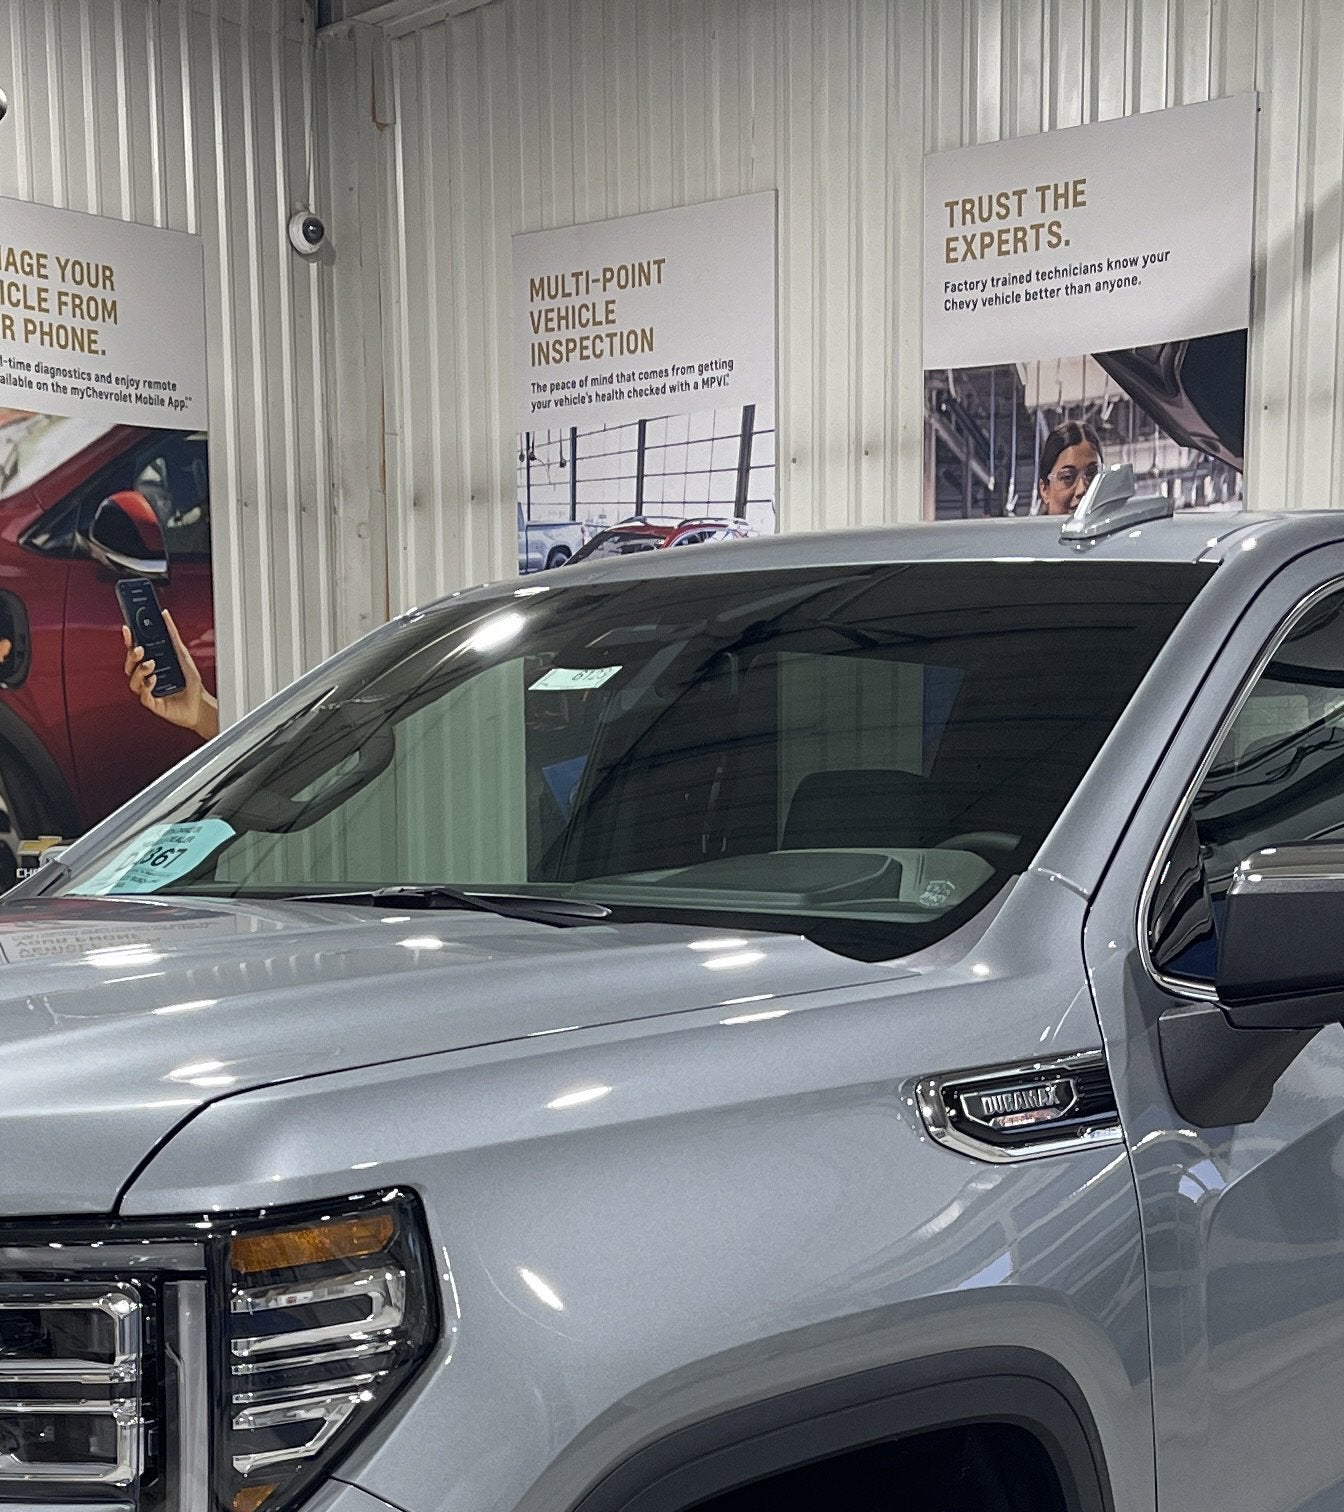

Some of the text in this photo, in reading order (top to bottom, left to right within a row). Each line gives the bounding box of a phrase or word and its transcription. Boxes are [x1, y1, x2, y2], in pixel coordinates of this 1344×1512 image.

[944, 178, 1087, 228] TRUST THE
[945, 220, 1070, 264] EXPERTS.
[55, 255, 115, 292] YOUR
[529, 258, 666, 302] MULTI-POINT
[944, 250, 1171, 294] Factory trained technicians know your
[58, 290, 118, 326] FROM
[944, 275, 1142, 312] Chevy vehicle better than anyone.
[529, 299, 616, 334] VEHICLE
[24, 317, 107, 356] PHONE.
[531, 327, 654, 367] INSPECTION
[34, 361, 92, 381] diagnostics
[94, 372, 112, 384] and
[114, 374, 141, 390] enjoy
[142, 379, 177, 392] remote
[36, 381, 49, 392] on
[51, 381, 68, 395] the
[70, 386, 133, 404] myChevrolet
[135, 392, 165, 407] Mobile
[531, 358, 734, 395] The peace of mind that comes from getting
[531, 399, 551, 413] your
[554, 393, 593, 408] vehicle's
[595, 388, 625, 403] health
[627, 382, 666, 399] checked
[669, 380, 691, 393] with
[693, 382, 699, 390] a
[981, 1086, 1061, 1116] DURAMAX
